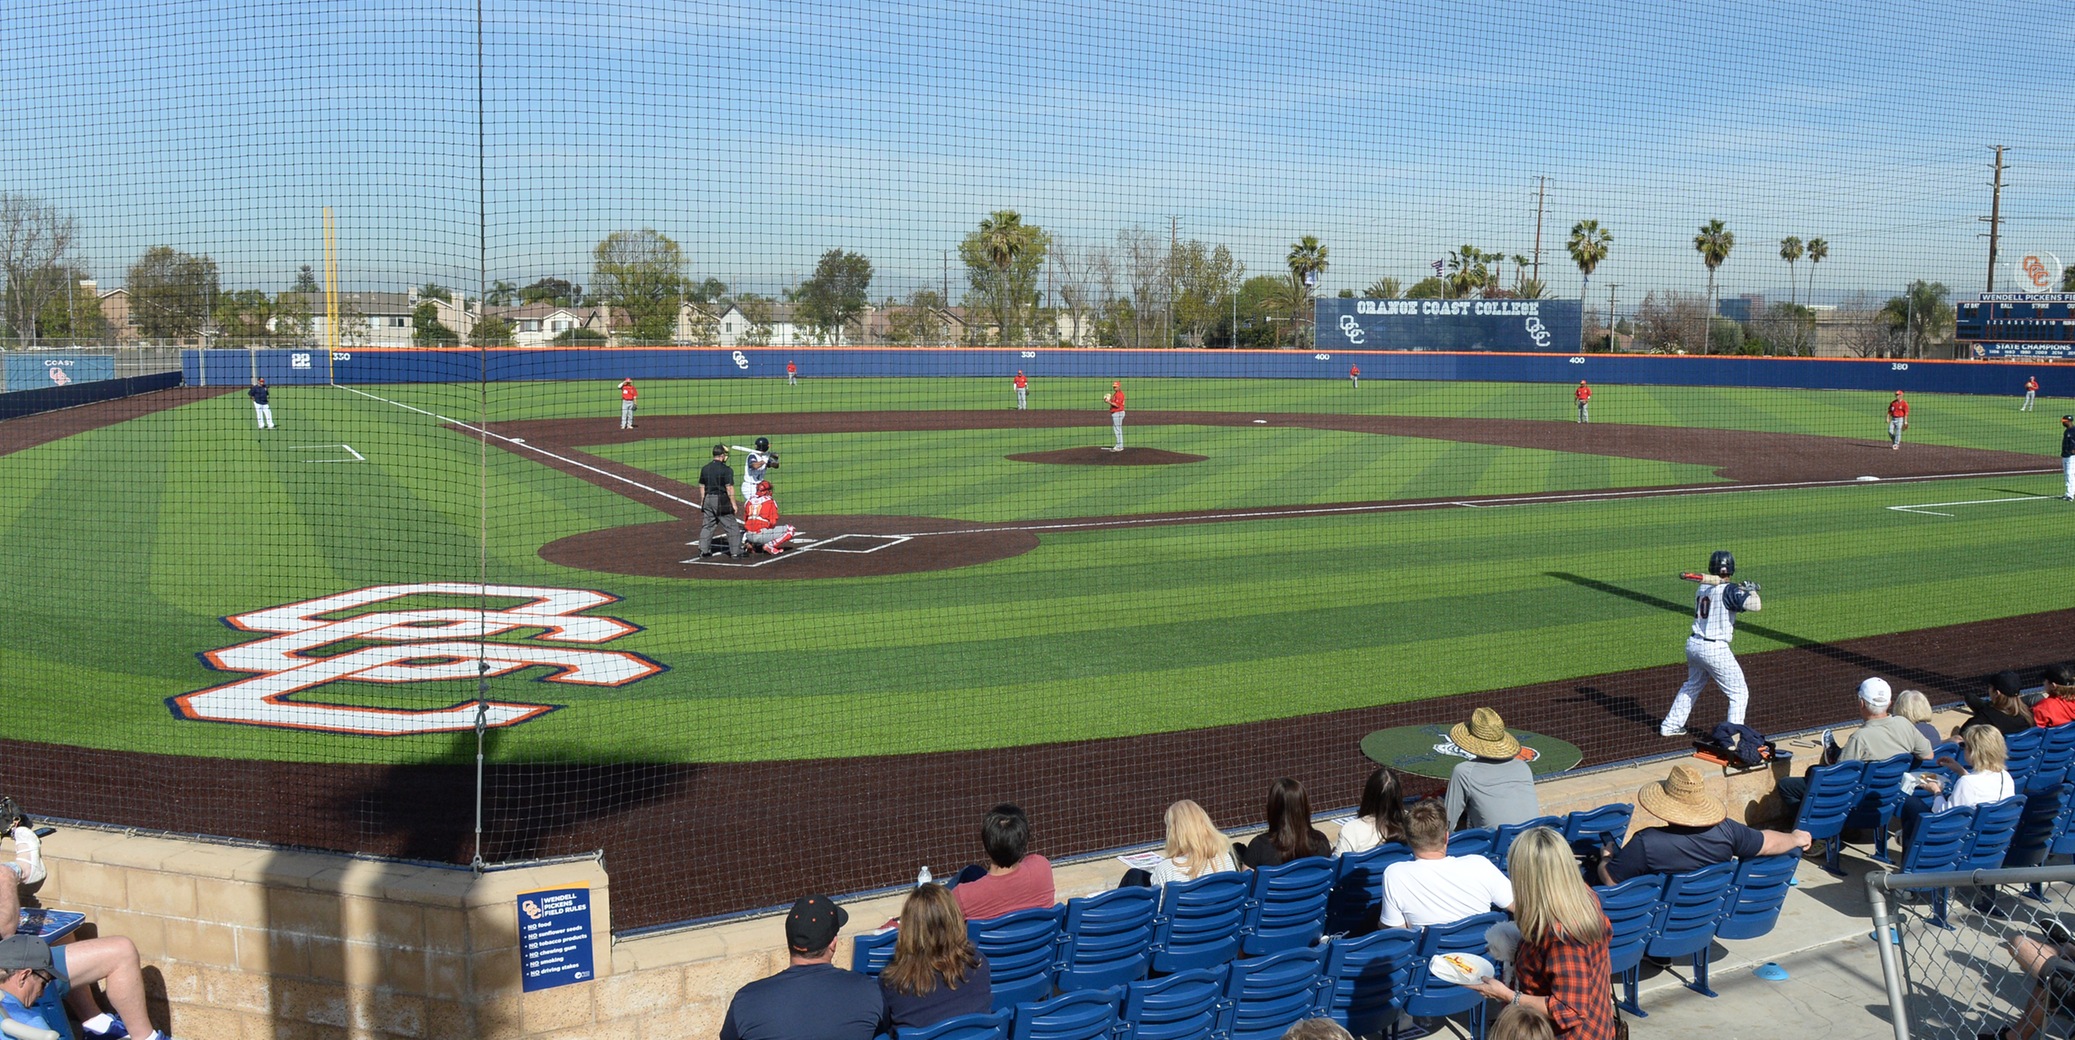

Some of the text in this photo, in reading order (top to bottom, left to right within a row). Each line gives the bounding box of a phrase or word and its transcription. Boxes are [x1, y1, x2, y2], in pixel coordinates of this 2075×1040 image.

[2024, 256, 2048, 286] OCC
[1357, 301, 1538, 316] ORANGE COAST COLLEGE
[1339, 314, 1365, 344] OCC
[1525, 317, 1551, 347] OCC
[1892, 363, 1908, 371] 380
[544, 893, 577, 903] WENDELL
[522, 900, 542, 920] OCC
[544, 901, 573, 910] PICKENS
[545, 904, 586, 916] FIELD RULES
[538, 929, 565, 938] sunflower
[562, 934, 587, 943] products
[540, 948, 563, 957] chewing
[540, 956, 564, 965] smoking
[541, 965, 560, 974] driving
